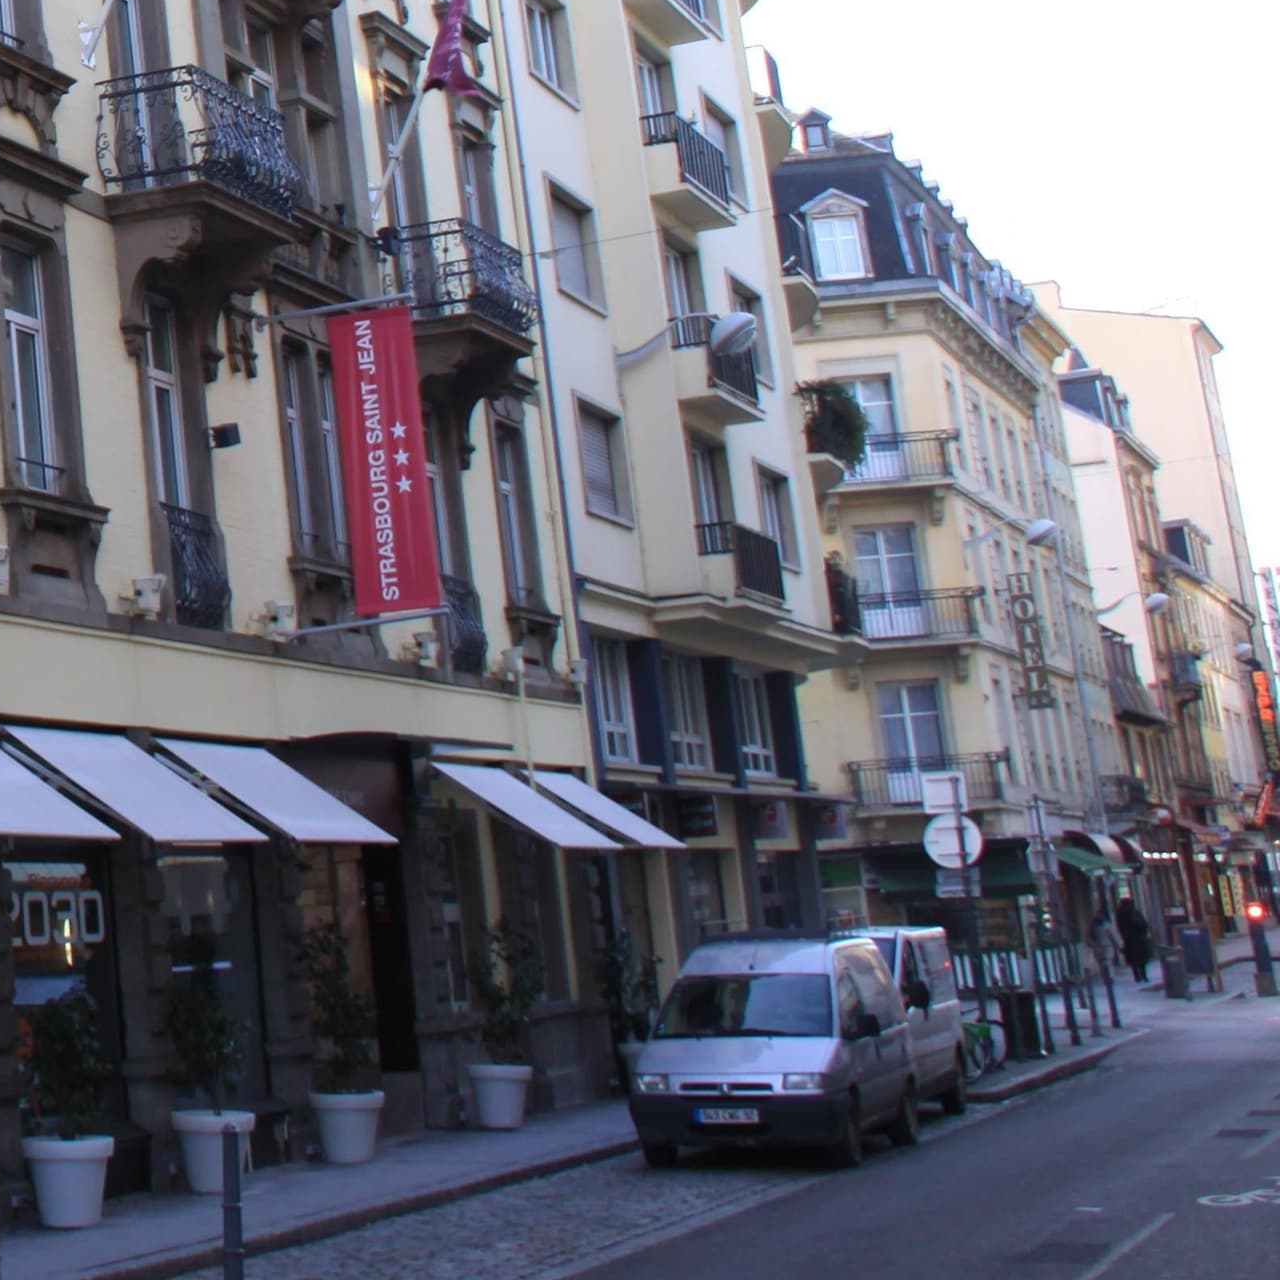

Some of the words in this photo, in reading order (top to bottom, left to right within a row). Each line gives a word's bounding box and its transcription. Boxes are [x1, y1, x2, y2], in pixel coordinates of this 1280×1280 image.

[354, 319, 376, 375] JEAN
[361, 382, 383, 444] SAINT
[367, 449, 400, 601] STRASBOURG
[1008, 574, 1049, 692] HOTEL
